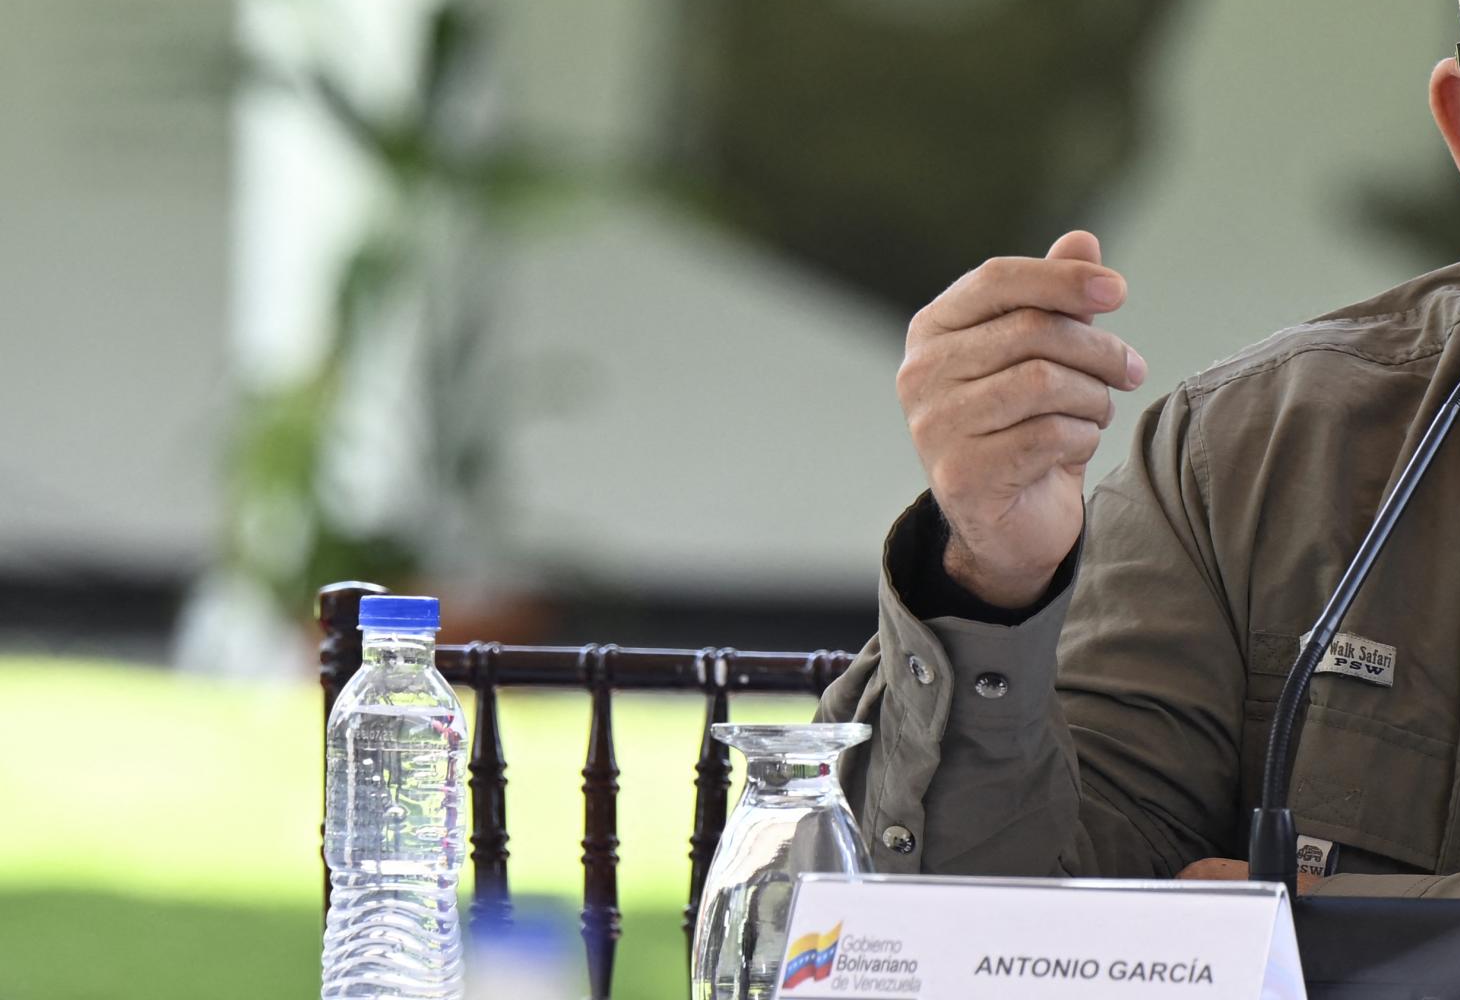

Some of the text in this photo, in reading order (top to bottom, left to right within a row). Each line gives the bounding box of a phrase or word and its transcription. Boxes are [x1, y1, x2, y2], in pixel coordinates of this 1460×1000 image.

[1330, 640, 1392, 668] Walk Safari
[1334, 658, 1385, 675] PSW
[841, 934, 903, 954] Gobierno
[836, 954, 918, 974] Bolivariano
[974, 956, 1214, 985] ANTONIO GARCÍA
[831, 975, 922, 993] de Venezuela
